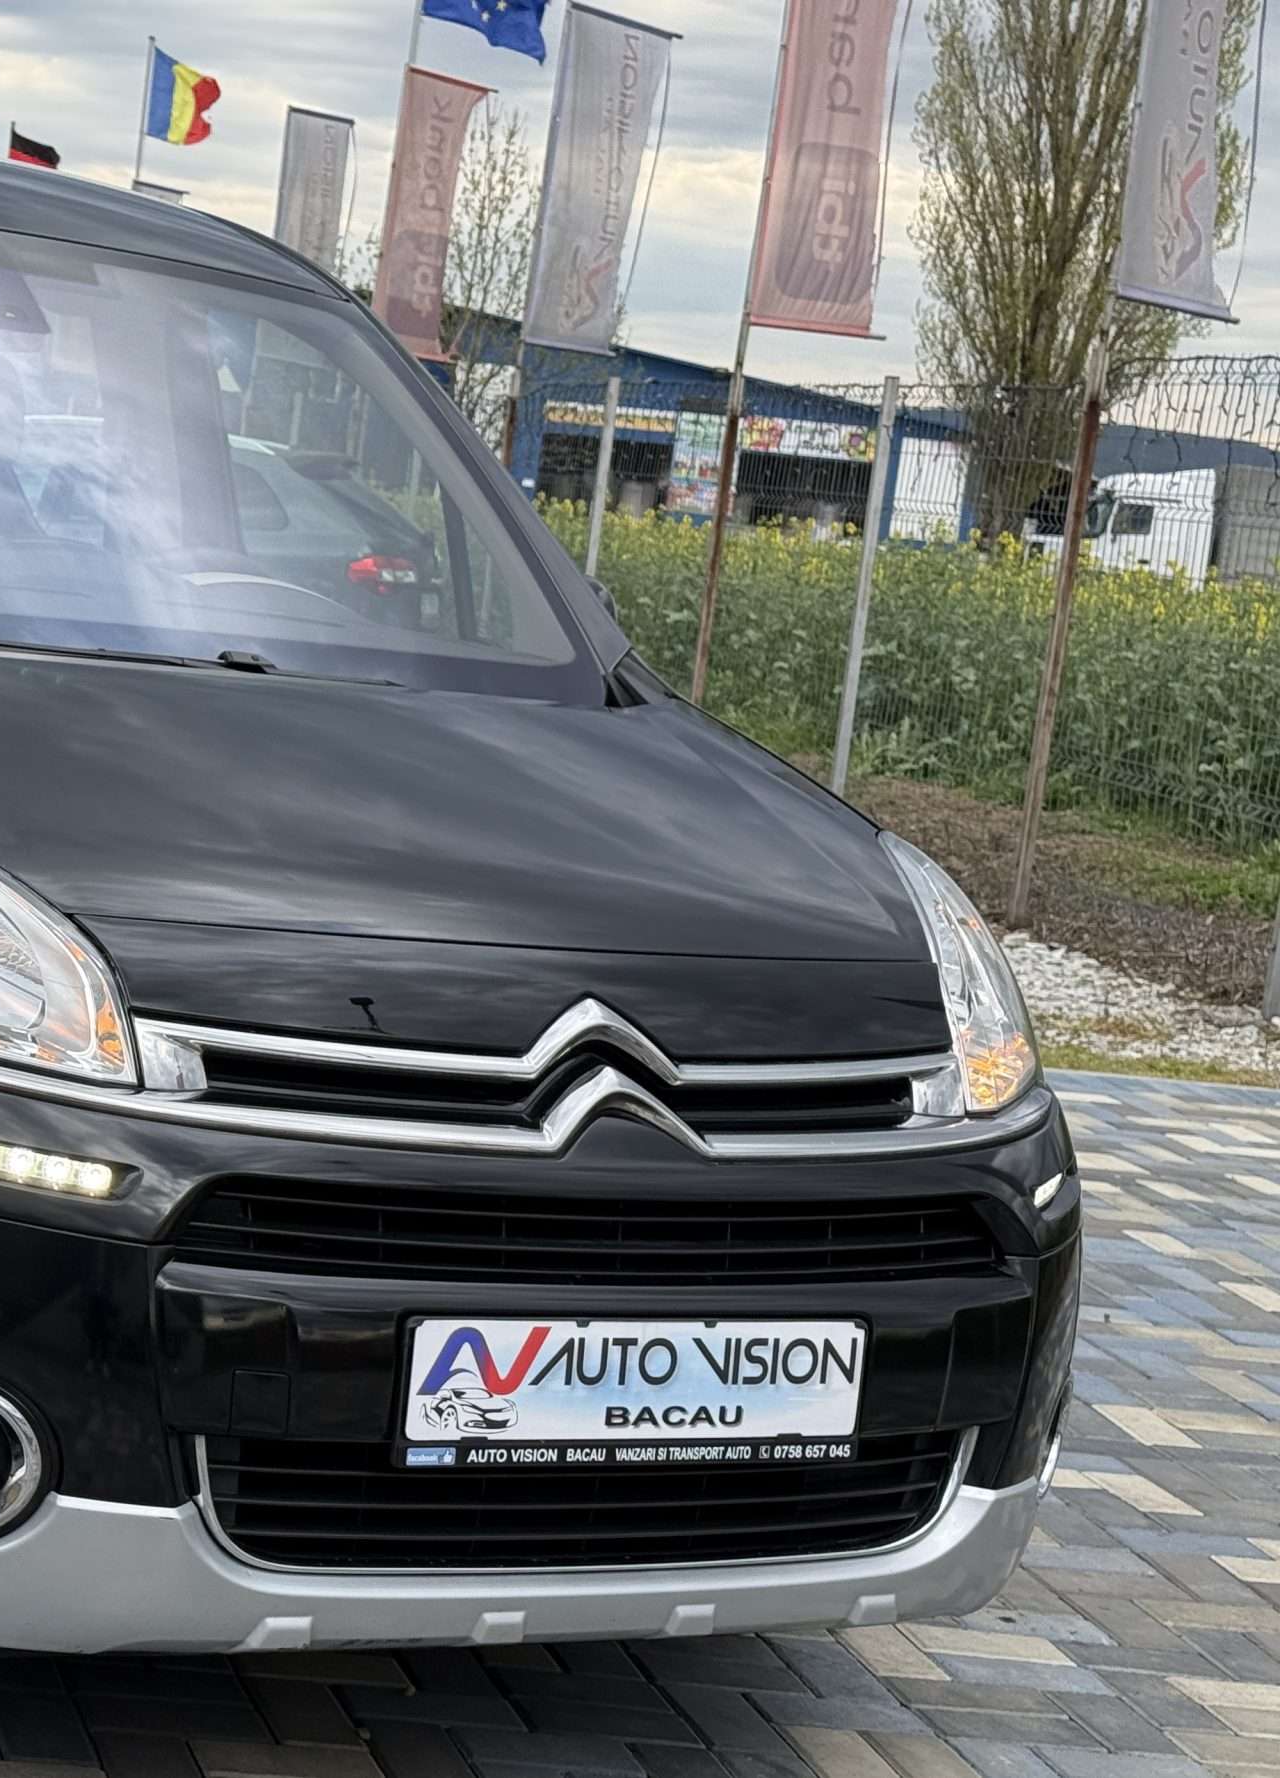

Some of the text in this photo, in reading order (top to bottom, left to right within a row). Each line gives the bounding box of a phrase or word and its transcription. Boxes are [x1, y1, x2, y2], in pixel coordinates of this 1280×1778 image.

[527, 1337, 678, 1386] AUTO
[692, 1337, 858, 1385] VISION
[604, 1405, 744, 1428] BACAU
[467, 1444, 852, 1463] AUTO VISION BACAU VANZARI SI TRANSPORT AUTO 0758 657 045
